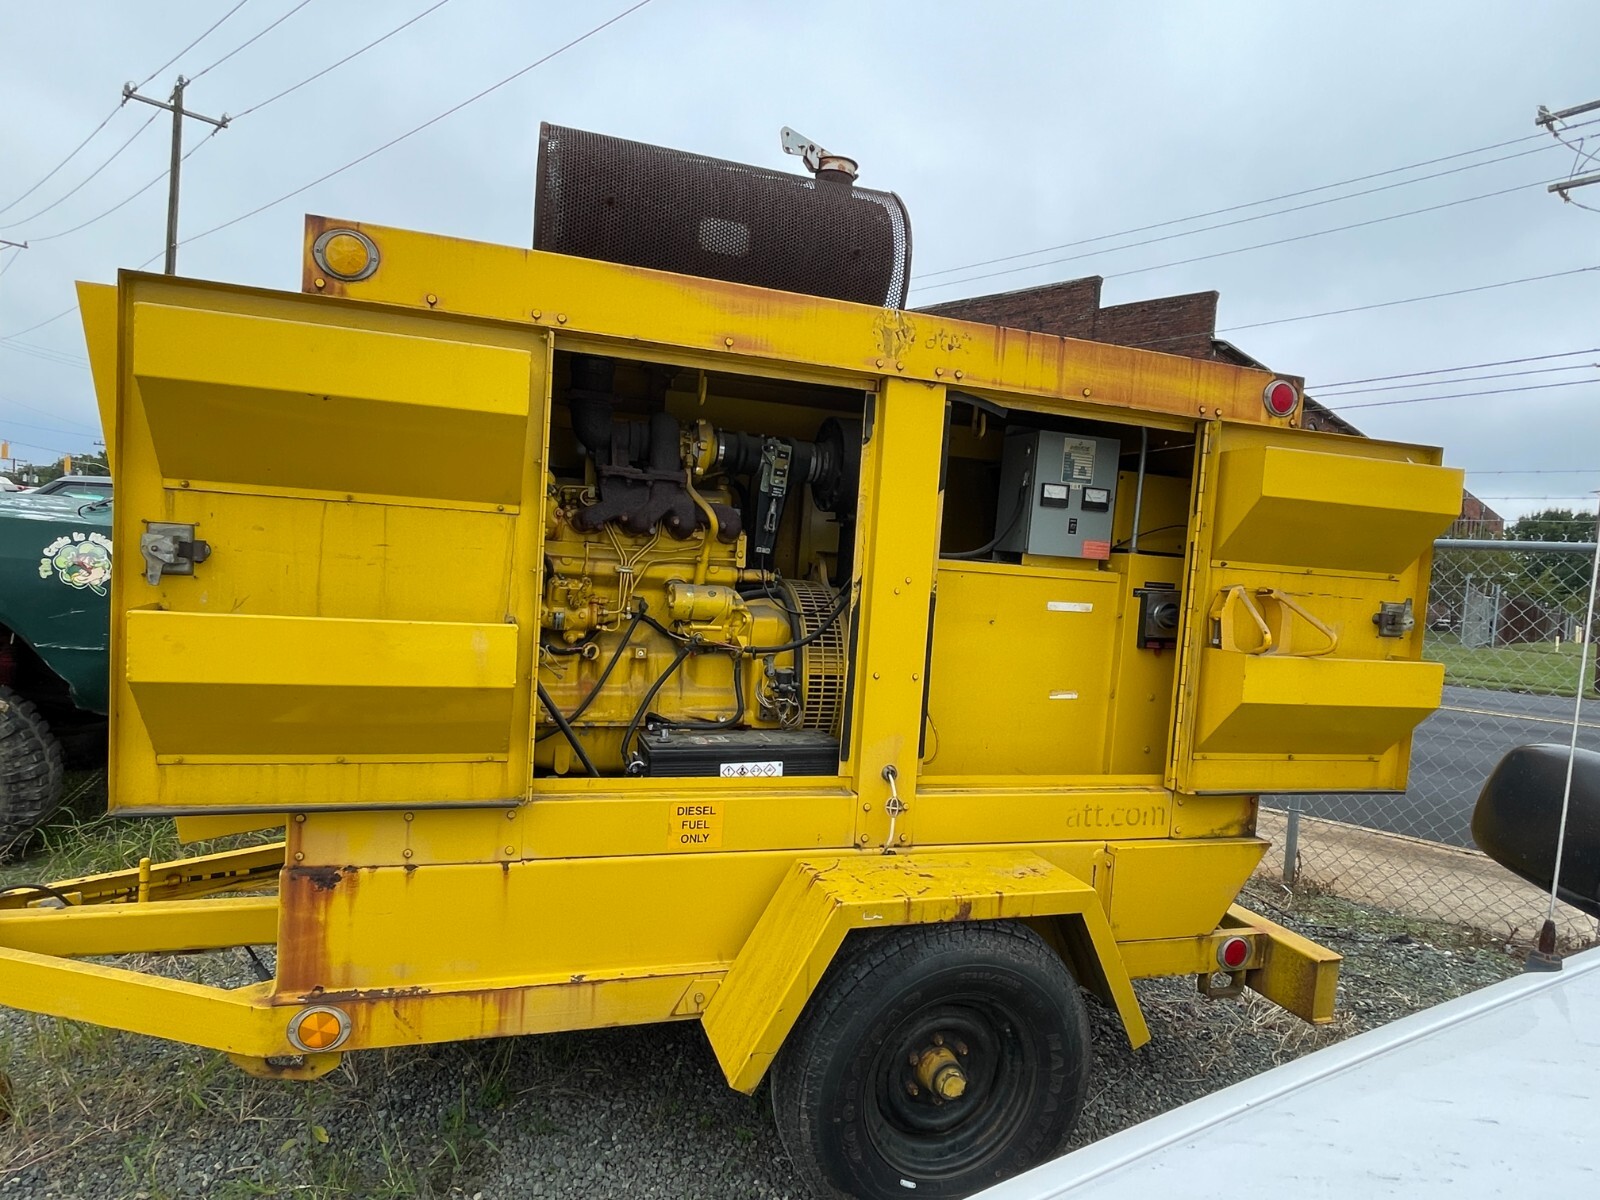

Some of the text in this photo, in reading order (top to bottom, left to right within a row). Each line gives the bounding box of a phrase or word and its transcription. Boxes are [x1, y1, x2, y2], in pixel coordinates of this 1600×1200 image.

[677, 806, 716, 816] DIESEL
[1066, 804, 1165, 828] att.com
[682, 820, 710, 829] FUEL
[680, 834, 710, 844] ONLY
